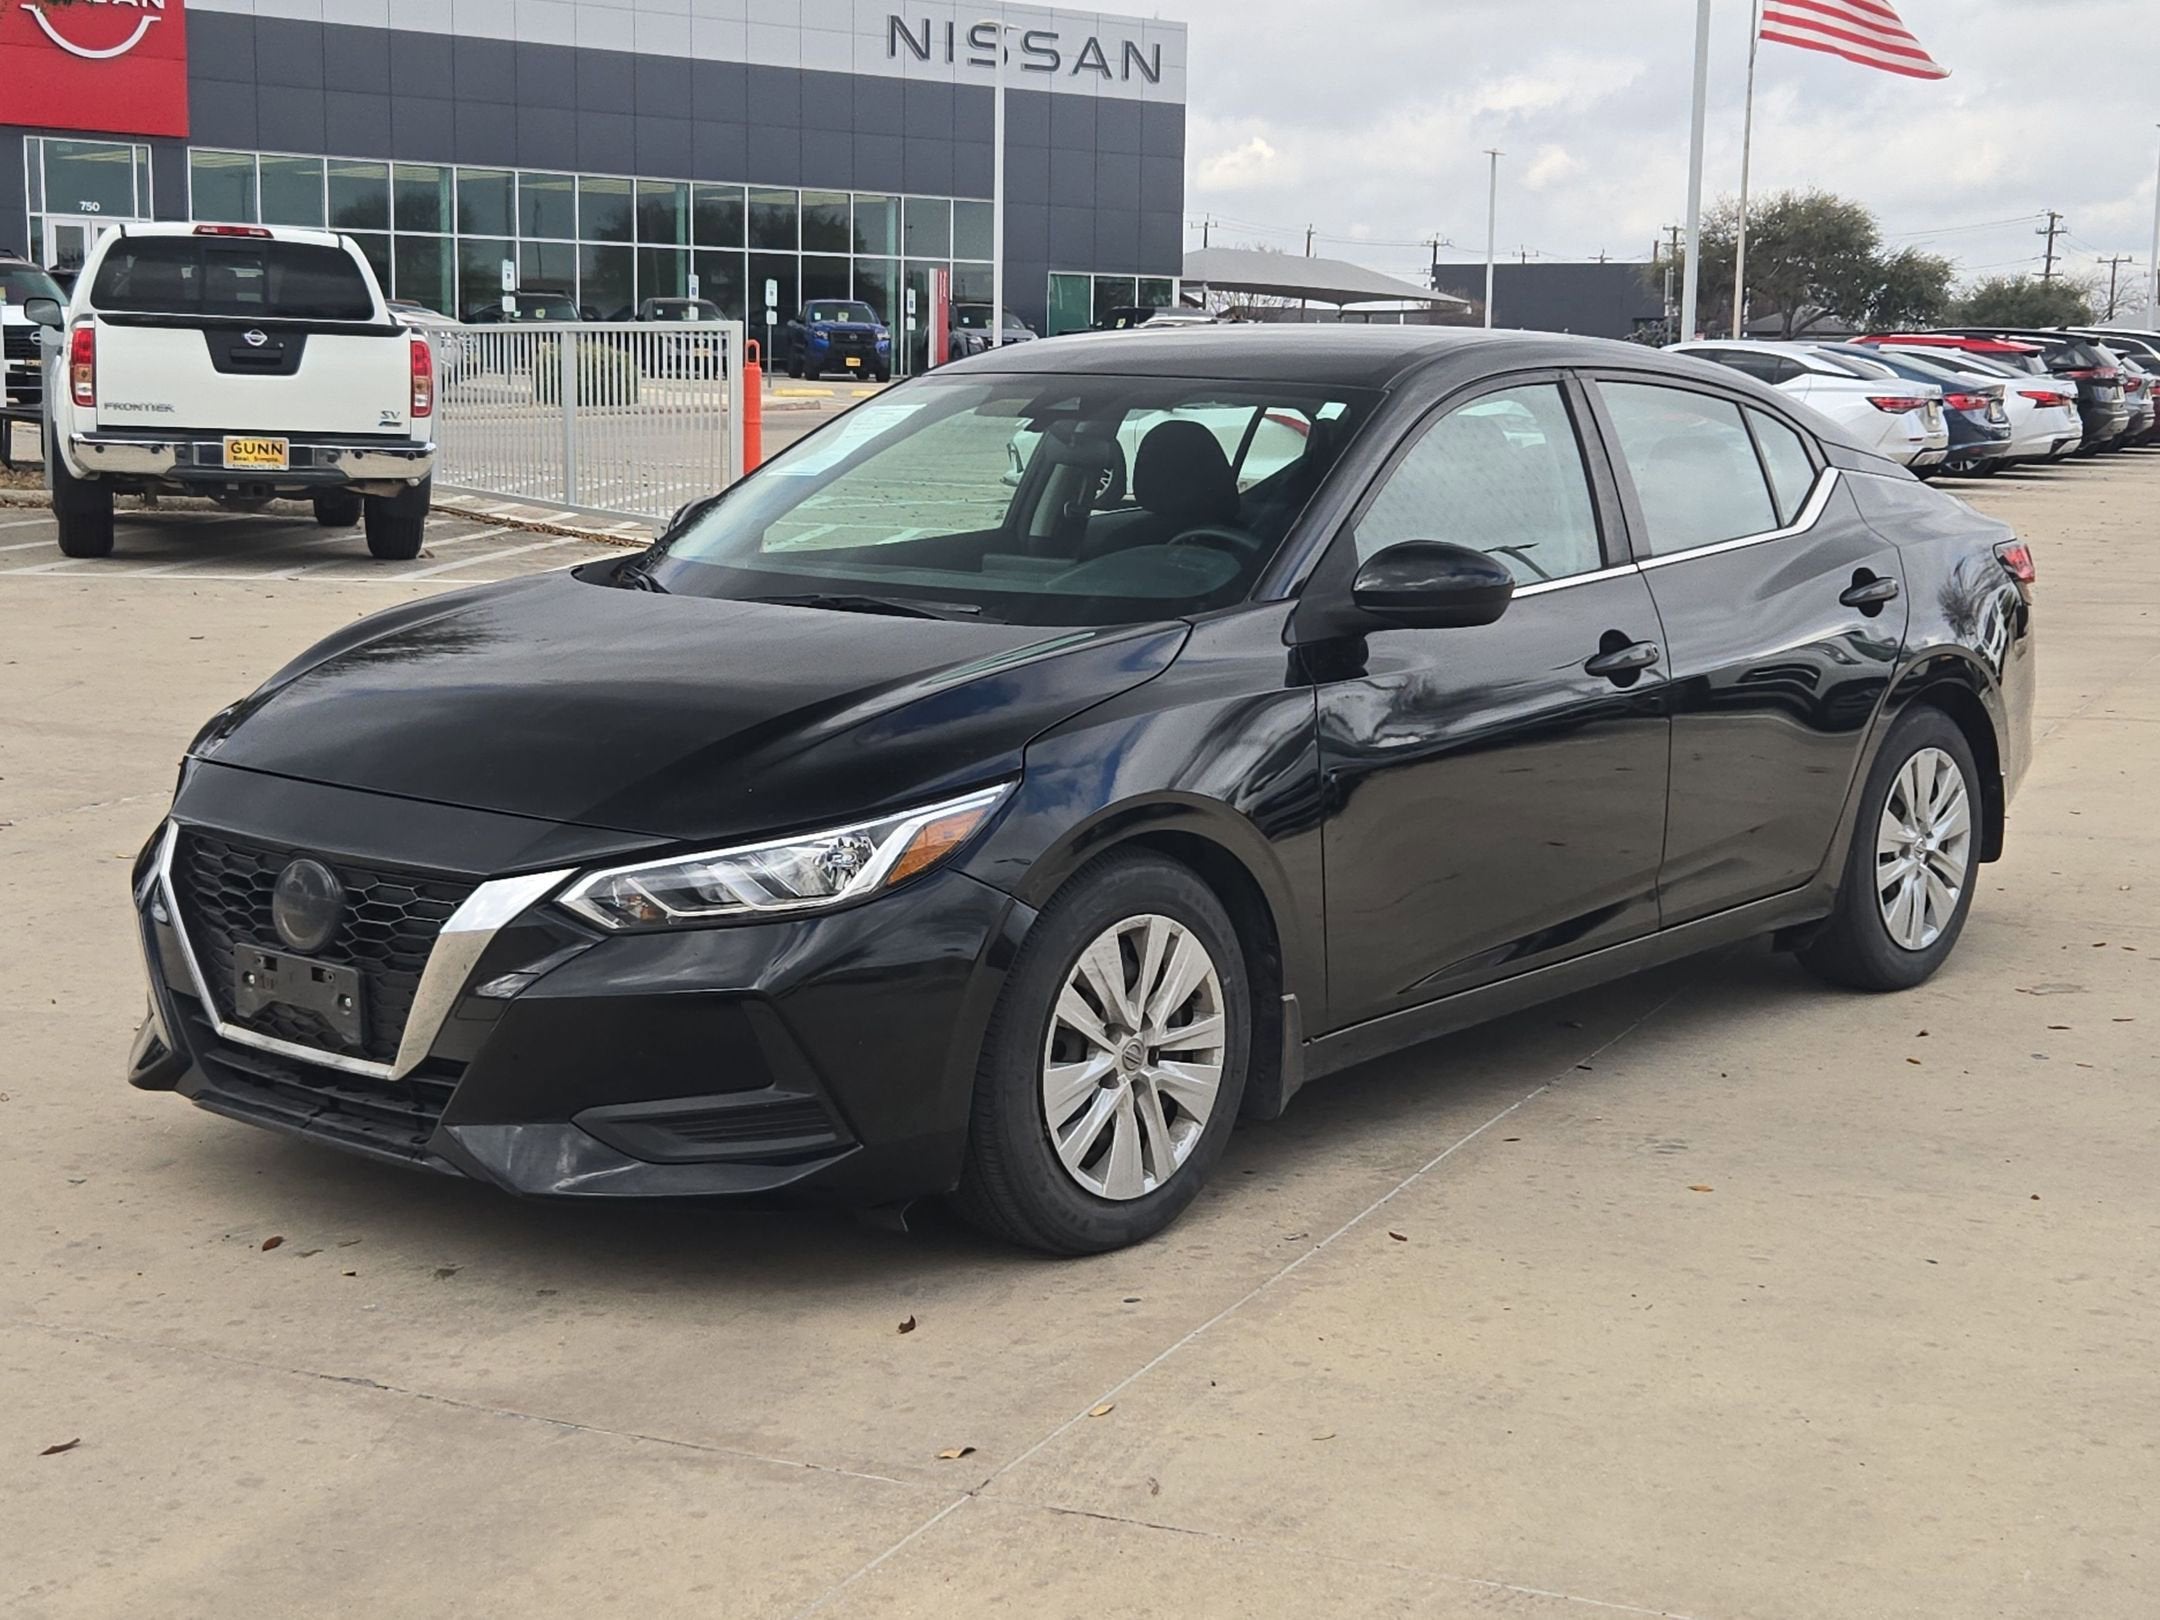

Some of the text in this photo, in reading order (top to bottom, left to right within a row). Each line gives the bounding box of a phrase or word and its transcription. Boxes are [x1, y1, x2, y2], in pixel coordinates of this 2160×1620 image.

[888, 14, 1161, 84] NISSAN
[79, 201, 101, 212] 750
[380, 410, 401, 419] SV
[230, 441, 283, 455] GUNN
